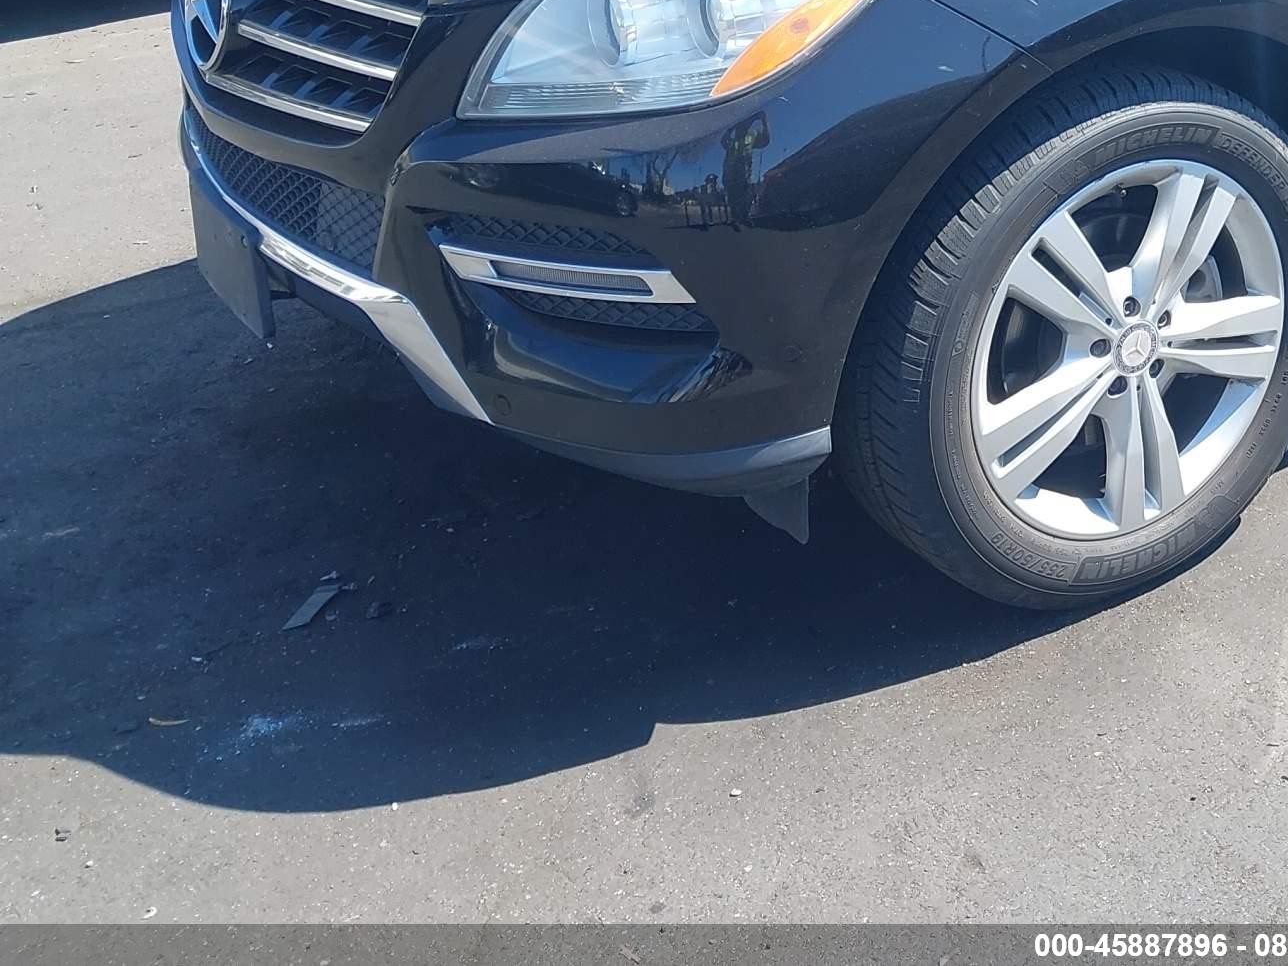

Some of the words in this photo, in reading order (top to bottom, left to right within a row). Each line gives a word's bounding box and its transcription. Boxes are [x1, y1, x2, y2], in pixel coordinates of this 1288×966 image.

[1095, 126, 1214, 162] MICHELIN
[1220, 137, 1287, 191] DEFENDER
[989, 531, 1066, 579] 255/50R19
[1077, 519, 1198, 581] MICHELIN
